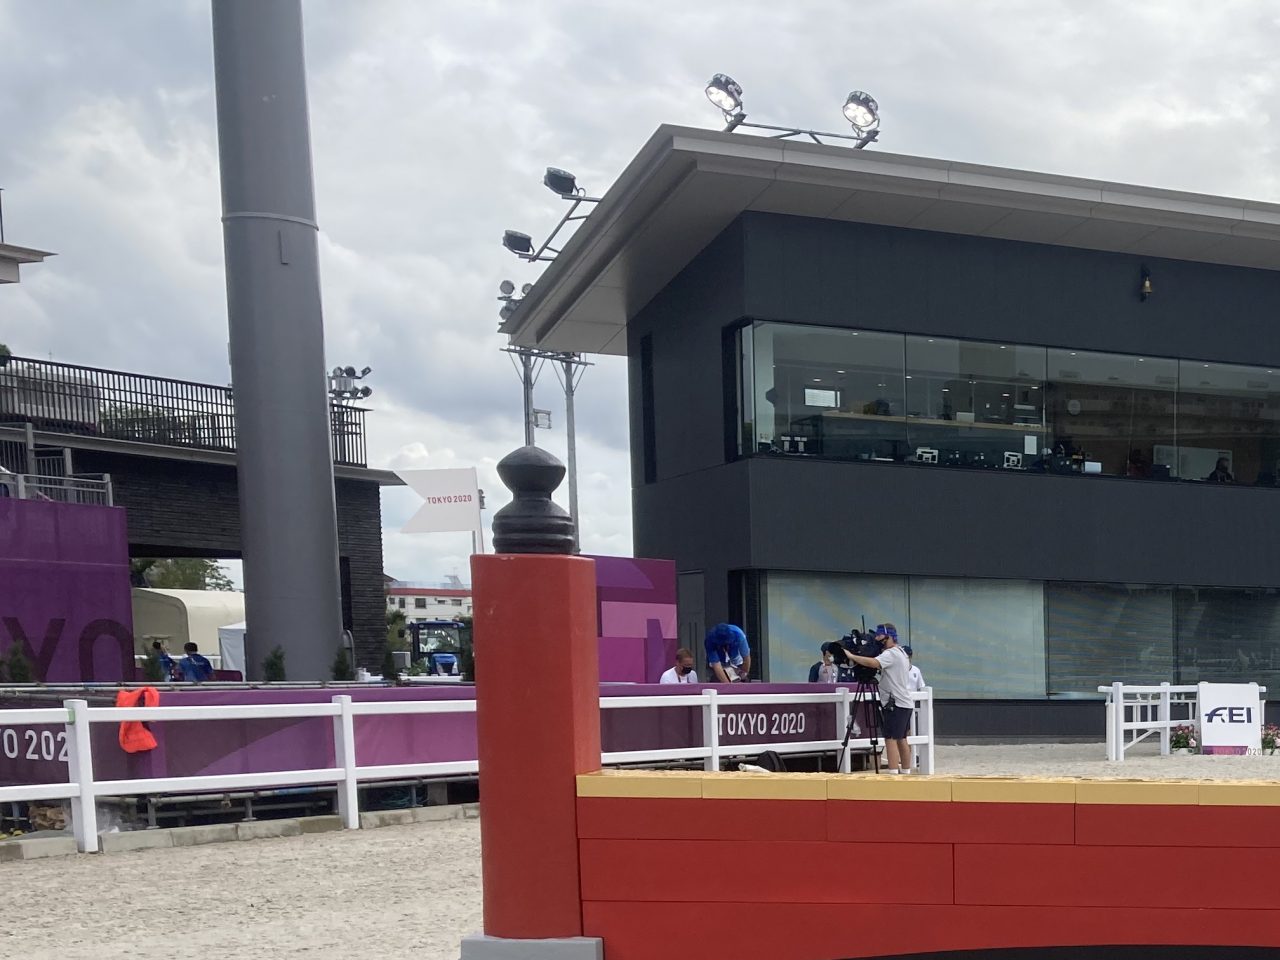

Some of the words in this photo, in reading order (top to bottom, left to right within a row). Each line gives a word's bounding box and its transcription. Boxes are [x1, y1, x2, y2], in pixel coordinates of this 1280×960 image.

[427, 495, 453, 505] TOKYO
[453, 494, 473, 503] 2020
[717, 713, 767, 736] TOKYO
[770, 712, 806, 735] 2020
[1204, 706, 1252, 724] FEI
